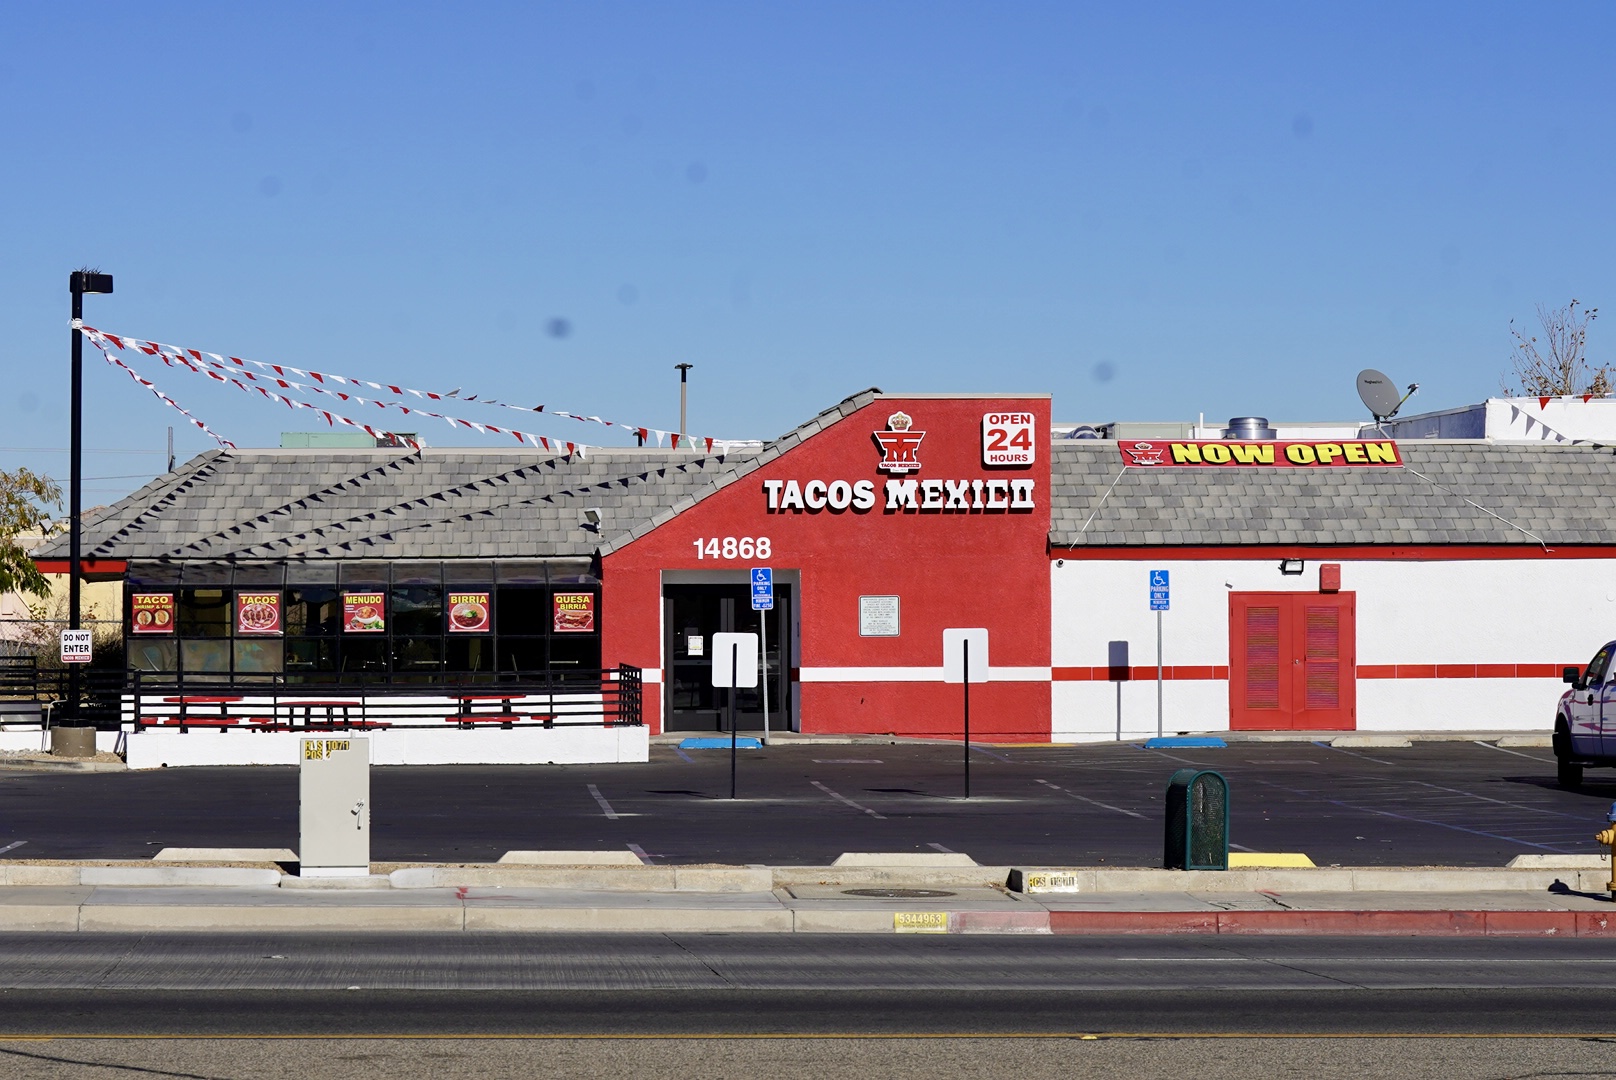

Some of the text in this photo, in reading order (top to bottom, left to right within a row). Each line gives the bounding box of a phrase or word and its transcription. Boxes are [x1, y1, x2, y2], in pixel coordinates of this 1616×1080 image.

[988, 414, 1031, 425] OPEN
[986, 428, 1032, 451] 24
[990, 454, 1029, 462] HOURS
[1170, 442, 1398, 464] NOW OPEN
[764, 479, 1036, 509] TACOS MEXICO
[693, 536, 772, 559] 14868
[136, 596, 169, 604] TACO
[240, 596, 277, 604] TACOS
[345, 596, 382, 604] MENUDO
[450, 596, 487, 604] BIRRIA
[63, 645, 90, 653] ENTER
[326, 740, 350, 750] 1071
[305, 750, 323, 760] POS
[899, 913, 942, 923] 5344963
